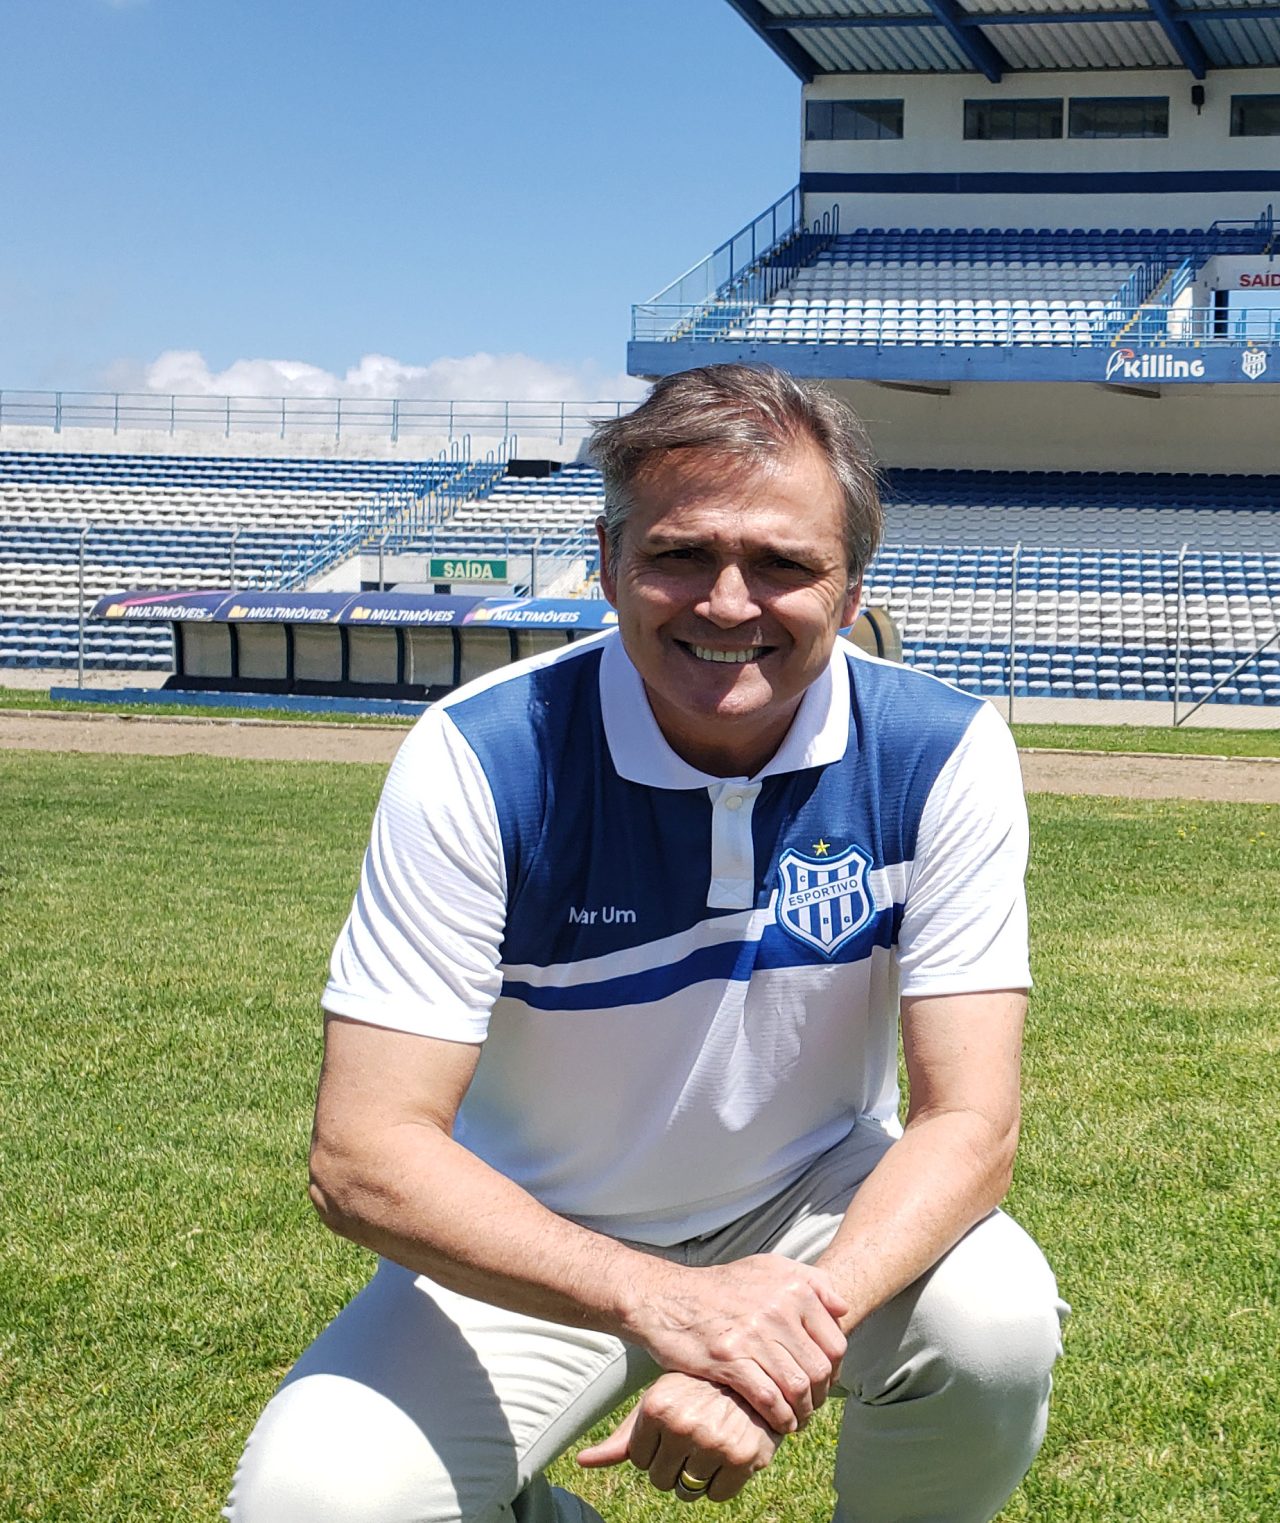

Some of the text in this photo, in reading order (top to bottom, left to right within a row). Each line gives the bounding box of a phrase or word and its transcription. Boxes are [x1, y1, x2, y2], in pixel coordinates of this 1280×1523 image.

[443, 560, 493, 578] SAÍDA
[126, 605, 207, 618] MULTIMÓVEIS
[247, 606, 330, 620] MULTIMÓVEIS
[370, 608, 455, 622] MULTIMÓVEIS
[493, 609, 579, 622] MULTIMÓVEIS
[788, 880, 858, 906] ESPORTIVO
[602, 906, 637, 924] Um
